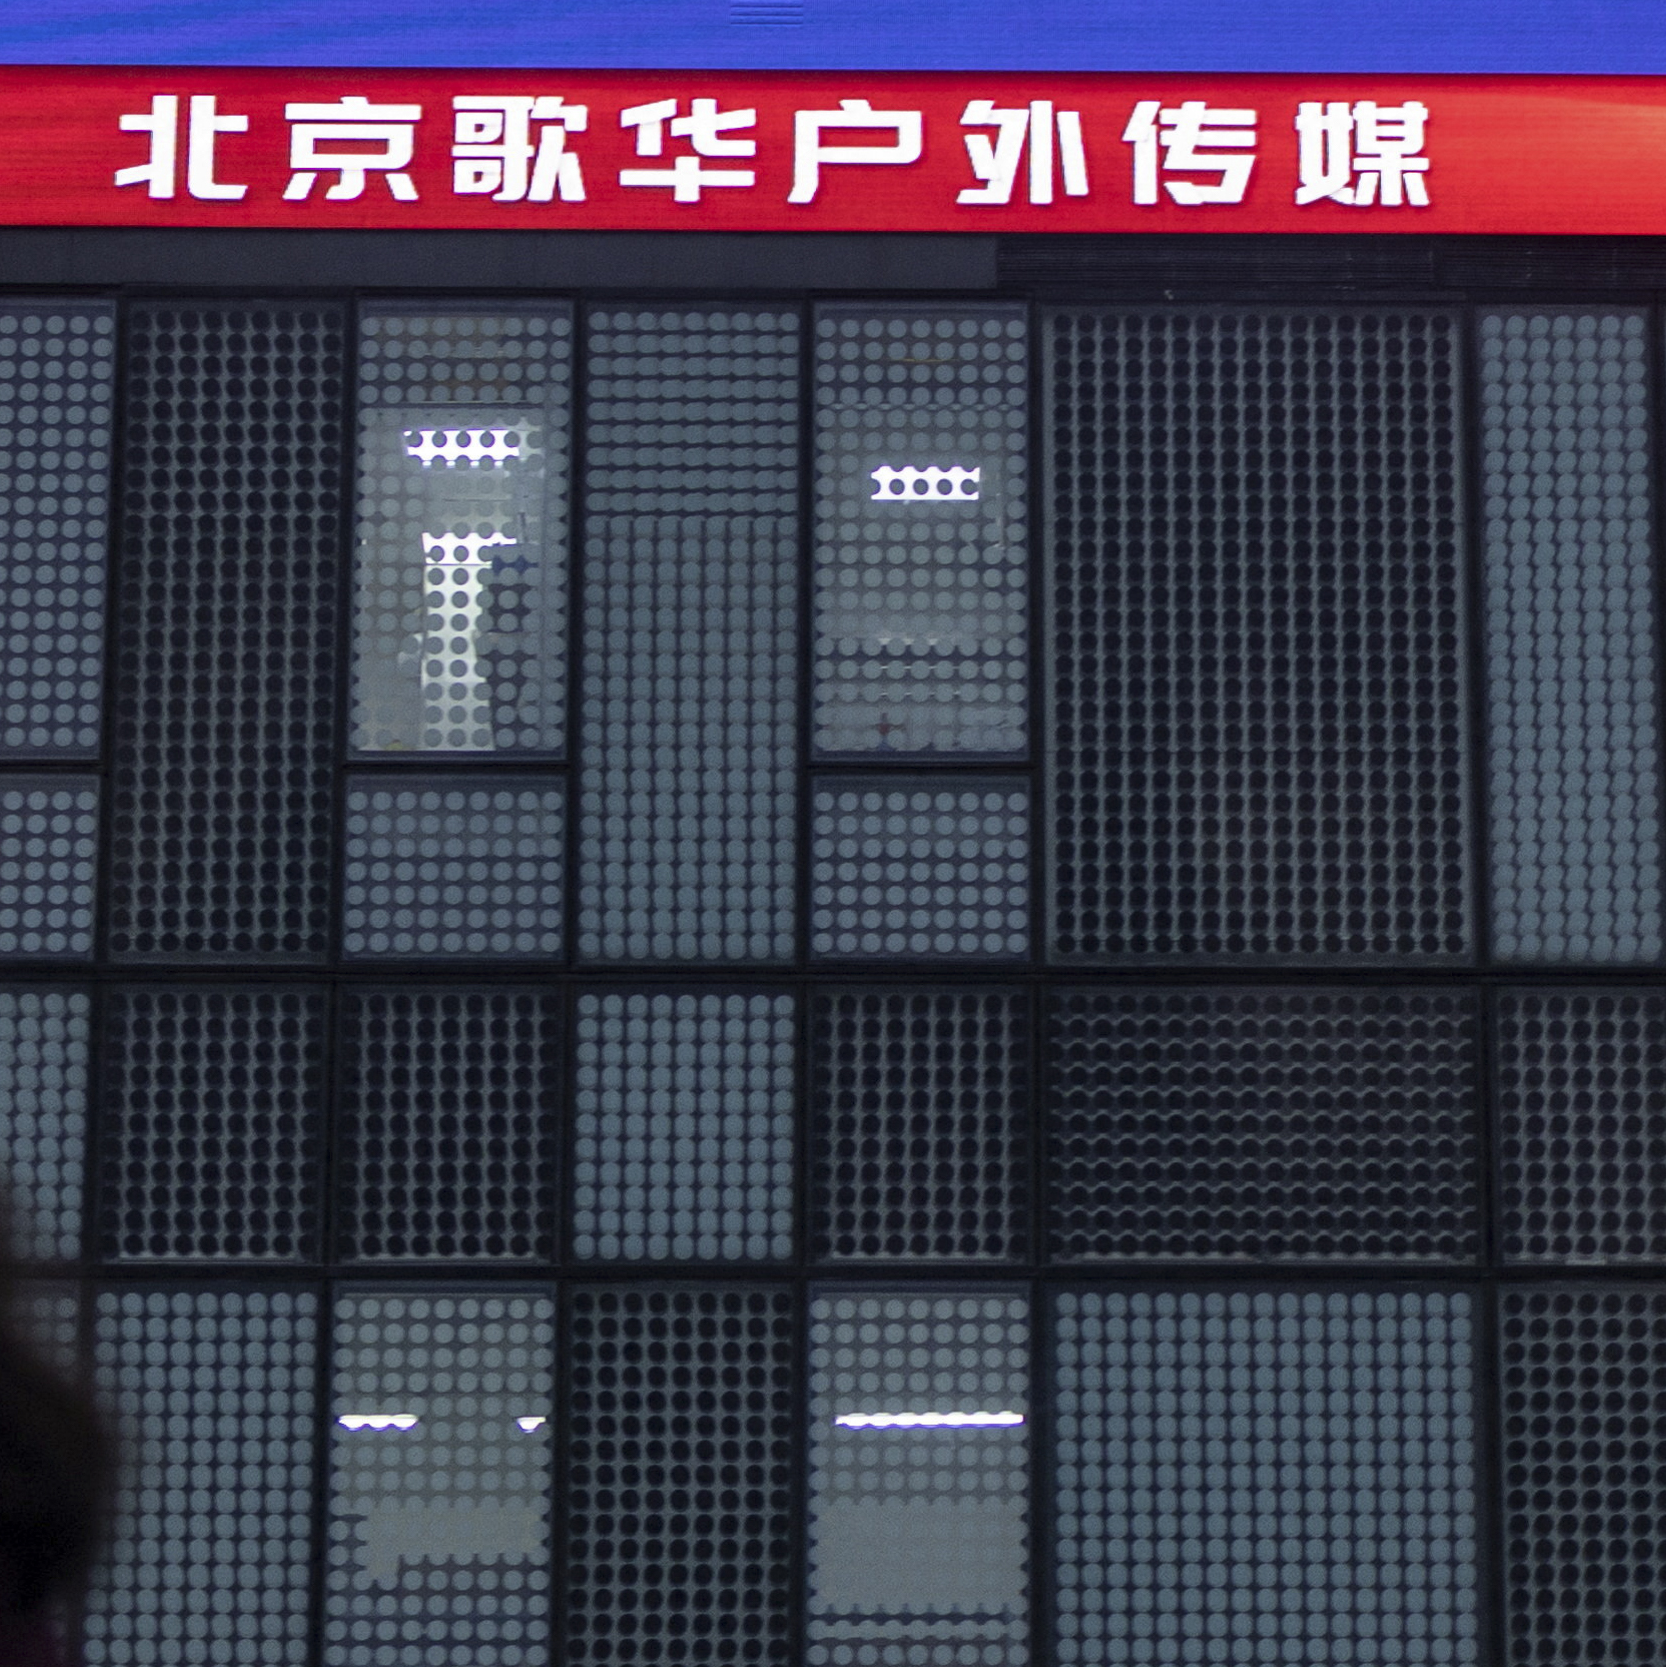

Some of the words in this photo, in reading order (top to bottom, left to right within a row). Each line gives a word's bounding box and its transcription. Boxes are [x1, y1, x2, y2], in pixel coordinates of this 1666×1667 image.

[114, 95, 1431, 206] 北京歌华户外传媒
